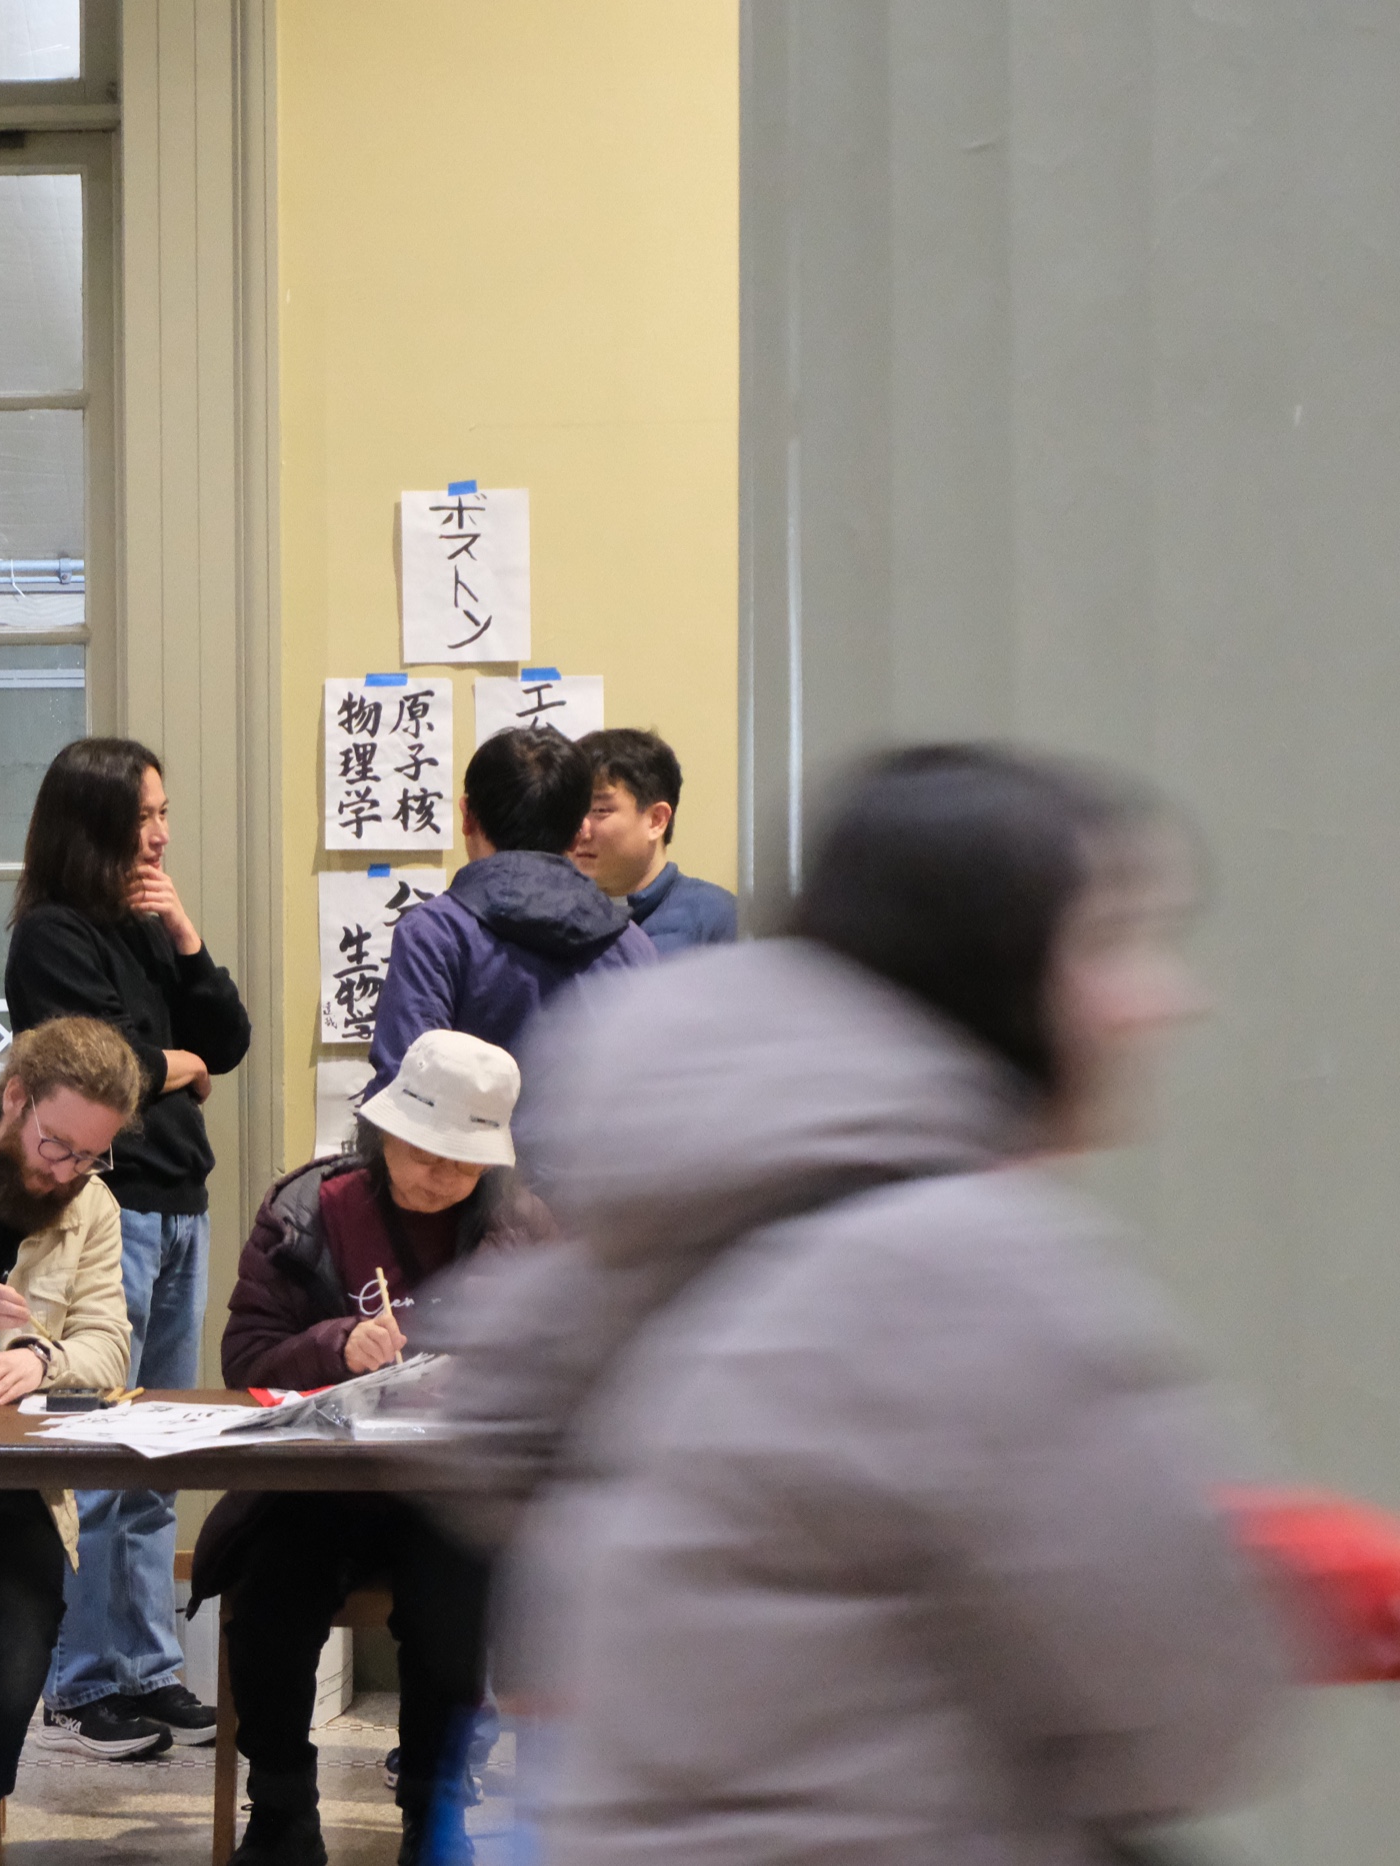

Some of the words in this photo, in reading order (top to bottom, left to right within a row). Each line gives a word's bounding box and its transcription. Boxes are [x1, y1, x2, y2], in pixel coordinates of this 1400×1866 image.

[429, 493, 493, 649] ボストン
[337, 691, 383, 839] 物理学
[388, 689, 444, 834] 原子核
[50, 1709, 82, 1735] HOKA
